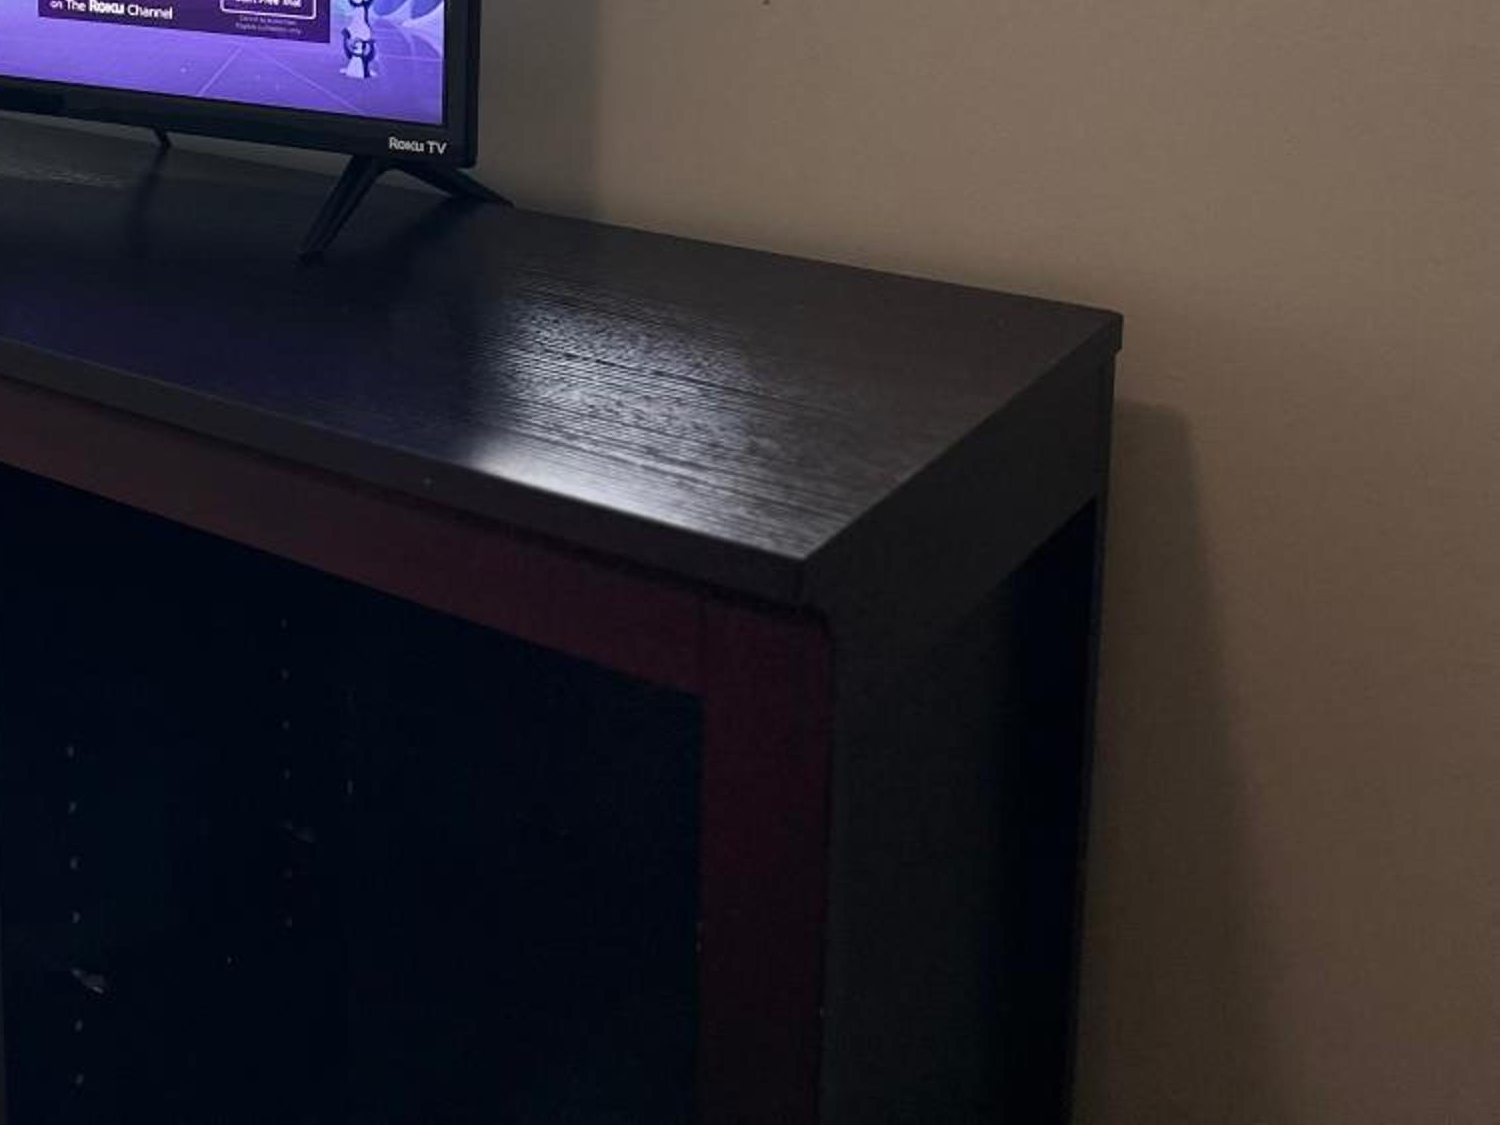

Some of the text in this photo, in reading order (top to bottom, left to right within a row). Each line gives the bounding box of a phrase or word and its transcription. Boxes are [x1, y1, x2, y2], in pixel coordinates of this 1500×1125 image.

[50, 0, 63, 9] on
[127, 3, 173, 20] Channel
[426, 140, 448, 155] TV
